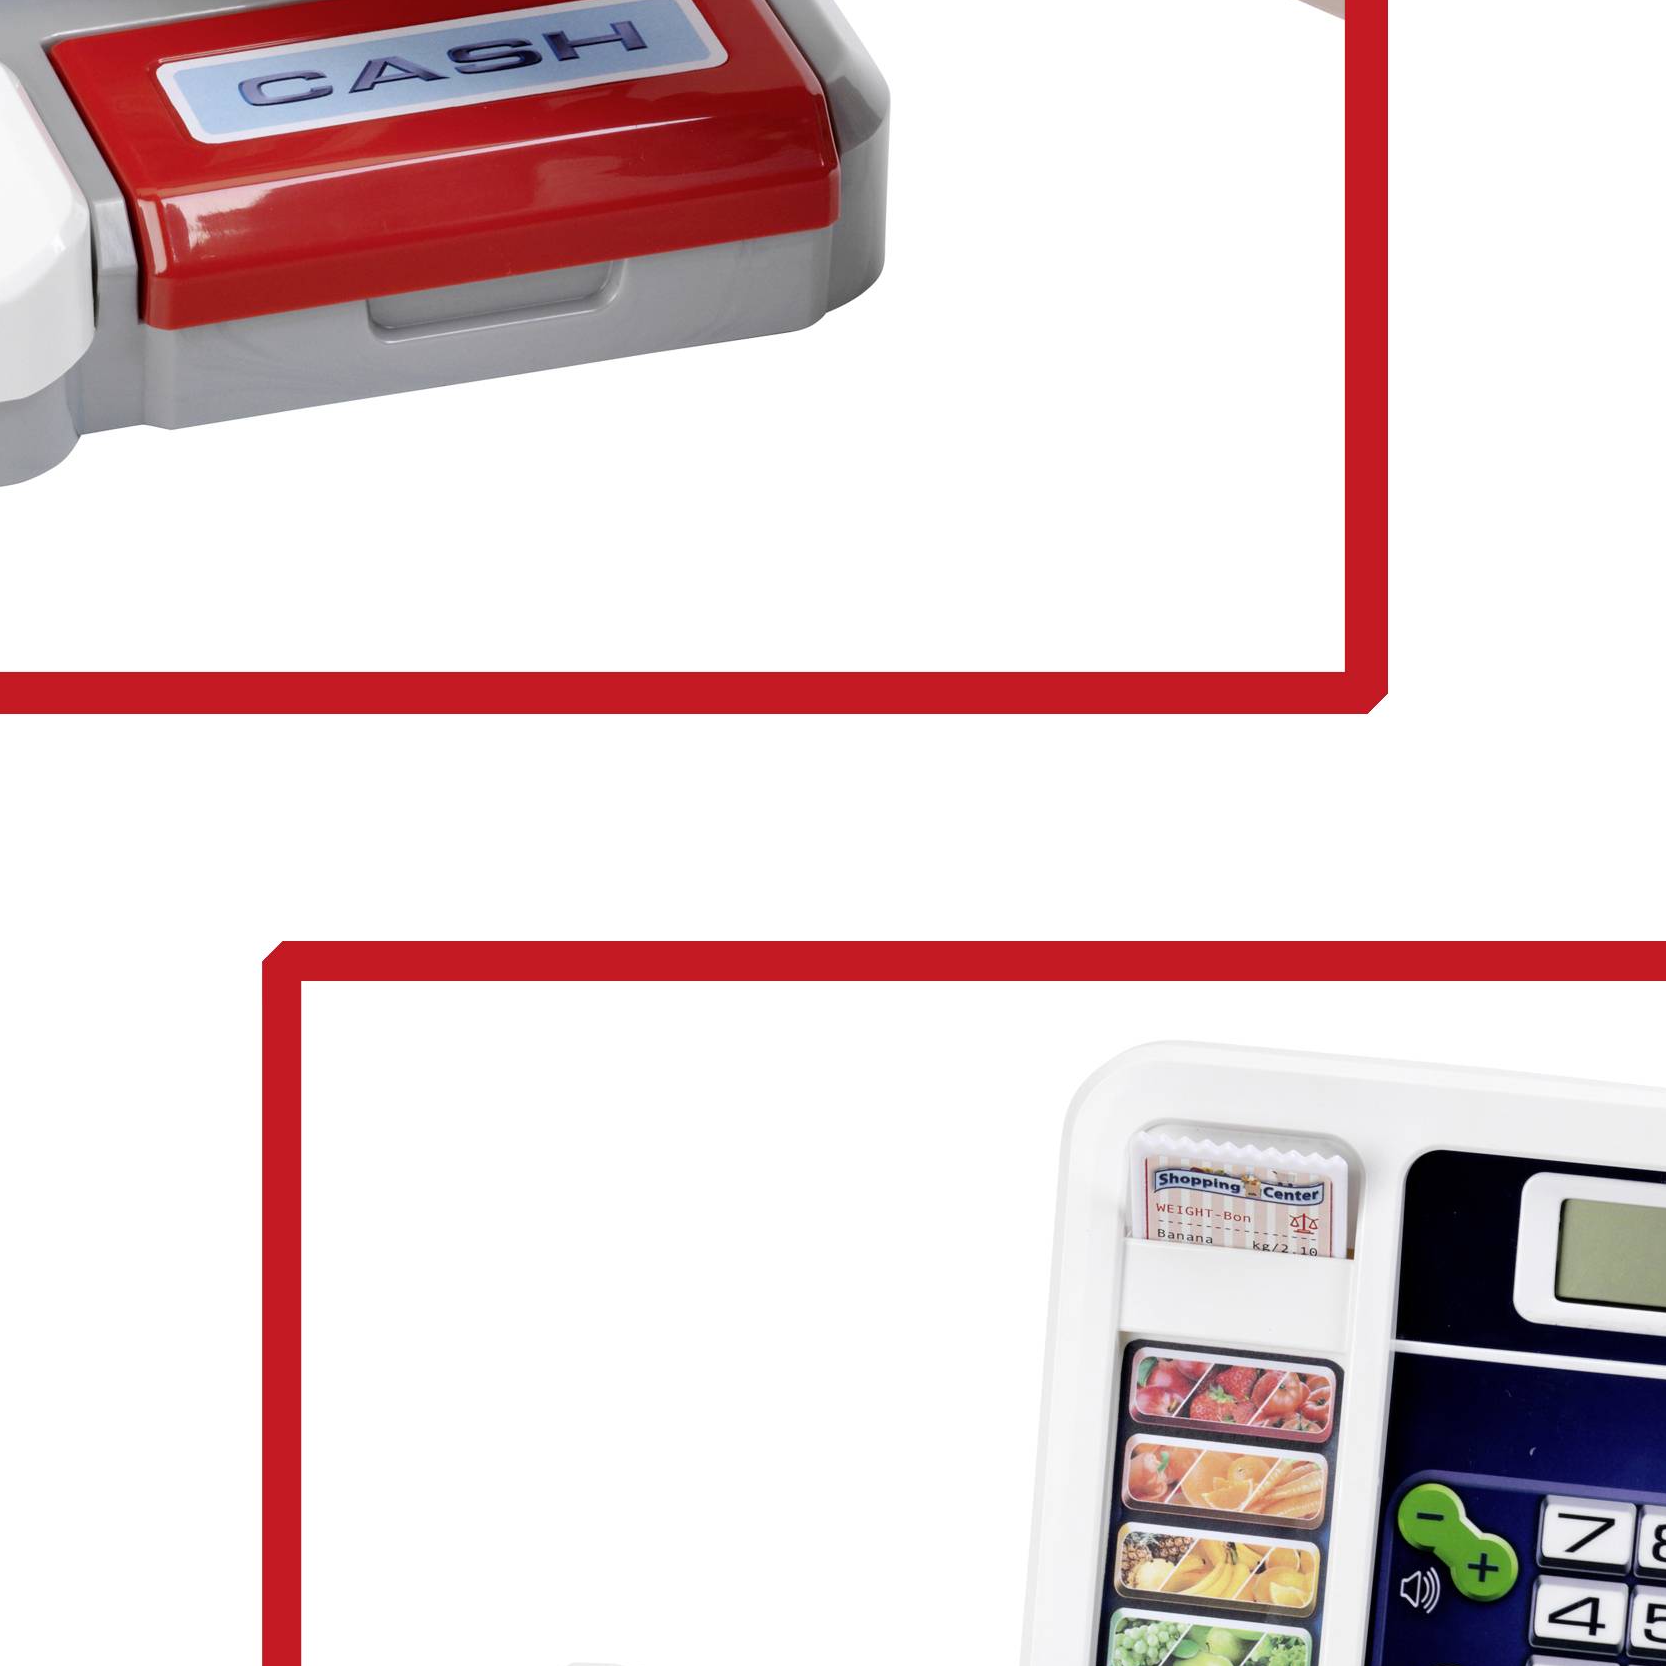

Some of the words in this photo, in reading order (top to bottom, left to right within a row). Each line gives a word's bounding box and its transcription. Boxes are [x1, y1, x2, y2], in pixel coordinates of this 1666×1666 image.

[237, 20, 648, 107] CASH
[1158, 1172, 1241, 1194] Shopping
[1263, 1185, 1319, 1201] Center
[1156, 1202, 1252, 1223] WEIGHT-Bon
[1157, 1228, 1214, 1245] Banana
[1558, 1512, 1616, 1553] 7
[1548, 1596, 1606, 1636] 4
